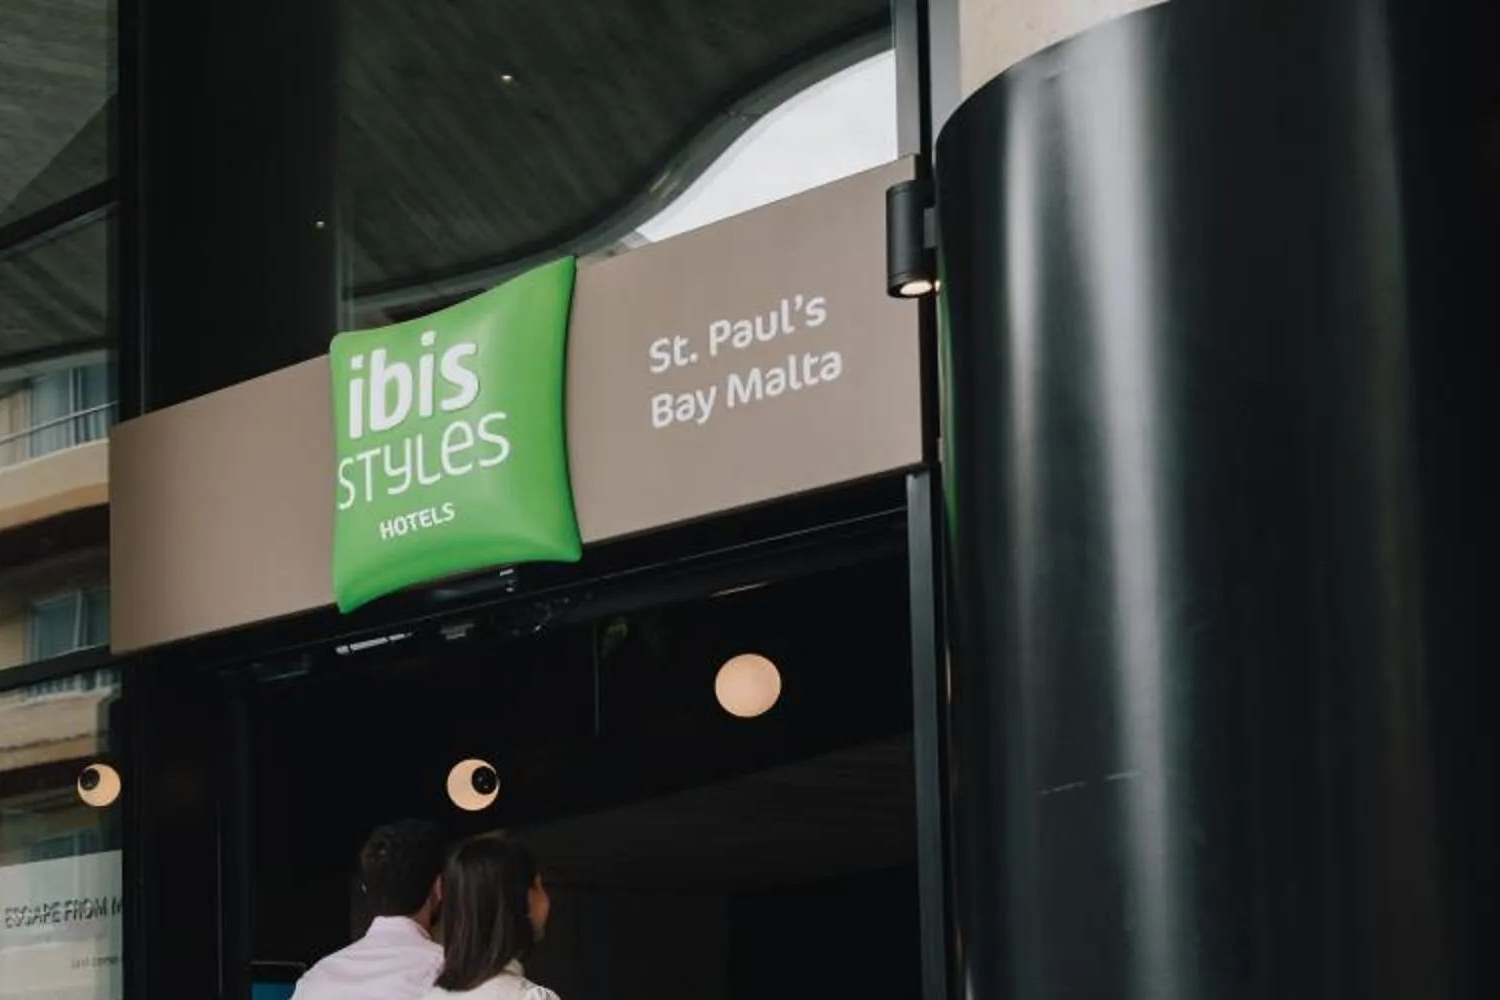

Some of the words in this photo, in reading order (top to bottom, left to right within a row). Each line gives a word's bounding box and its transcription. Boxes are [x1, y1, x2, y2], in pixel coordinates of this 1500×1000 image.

[648, 335, 700, 375] St.
[708, 294, 829, 358] Paul's
[349, 330, 480, 440] ibis
[650, 384, 718, 430] Bay
[726, 350, 845, 409] Malta
[380, 502, 455, 541] HOTELS
